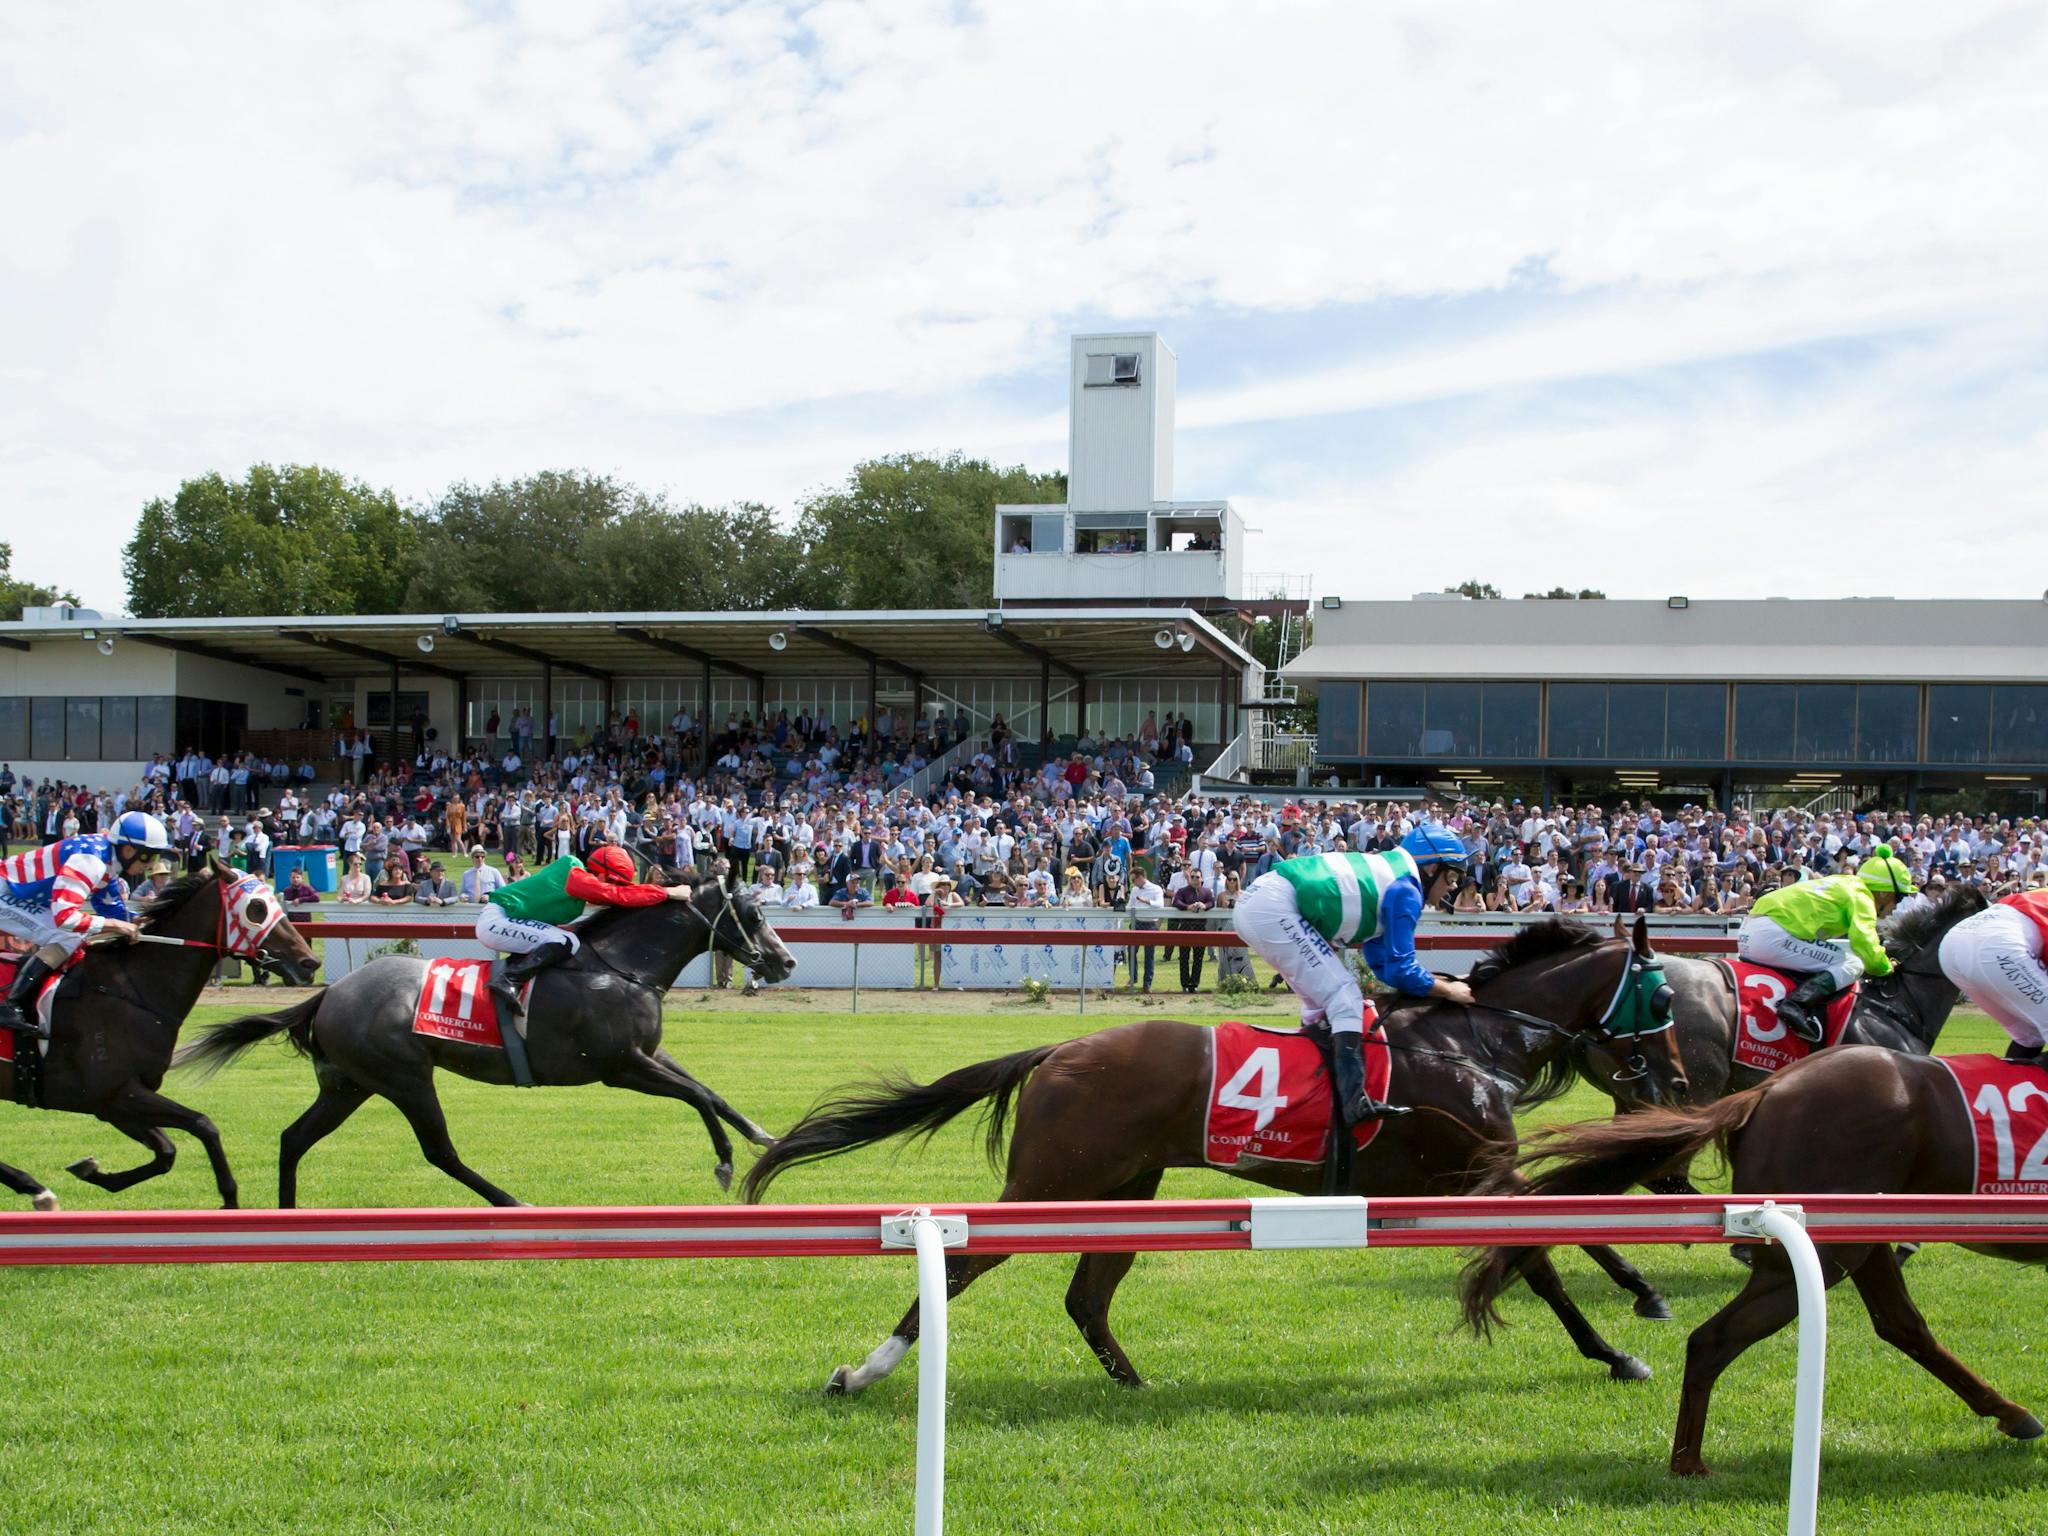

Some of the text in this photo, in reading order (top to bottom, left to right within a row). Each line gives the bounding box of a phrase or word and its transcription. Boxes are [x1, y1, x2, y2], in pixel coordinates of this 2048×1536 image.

[489, 924, 540, 943] L.KING
[429, 964, 480, 1020] 11
[1744, 973, 1787, 1042] 3
[419, 1012, 485, 1031] COMMERCIAL
[437, 1025, 464, 1038] CLUB
[1751, 1055, 1777, 1069] CLUB
[1217, 1047, 1288, 1131] 4
[1973, 1081, 2048, 1181] 12
